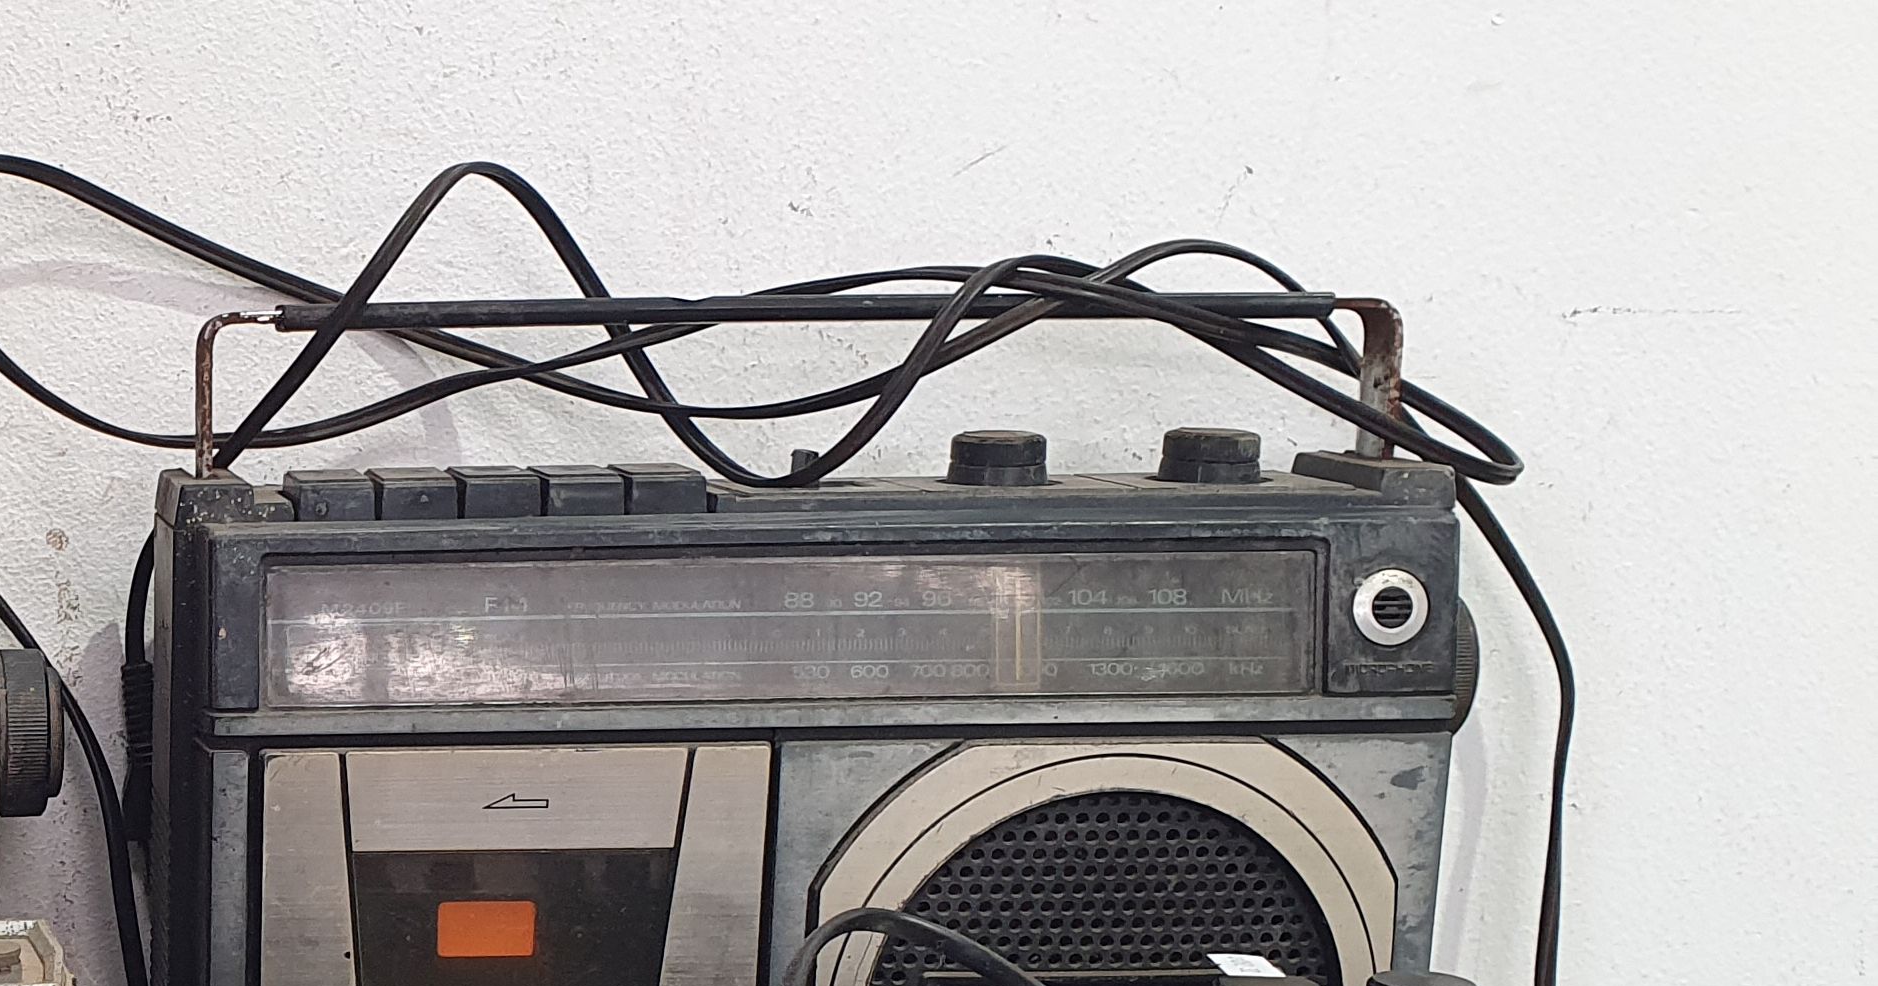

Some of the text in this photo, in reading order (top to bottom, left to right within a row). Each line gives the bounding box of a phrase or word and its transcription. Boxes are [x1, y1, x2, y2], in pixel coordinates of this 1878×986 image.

[784, 592, 815, 608] 88
[854, 591, 883, 608] 92
[1068, 588, 1108, 606] 104
[1148, 588, 1187, 606] 108
[1221, 588, 1273, 604] MHz
[850, 664, 889, 679] 600
[911, 664, 947, 678] 700
[1089, 662, 1133, 676] 1300
